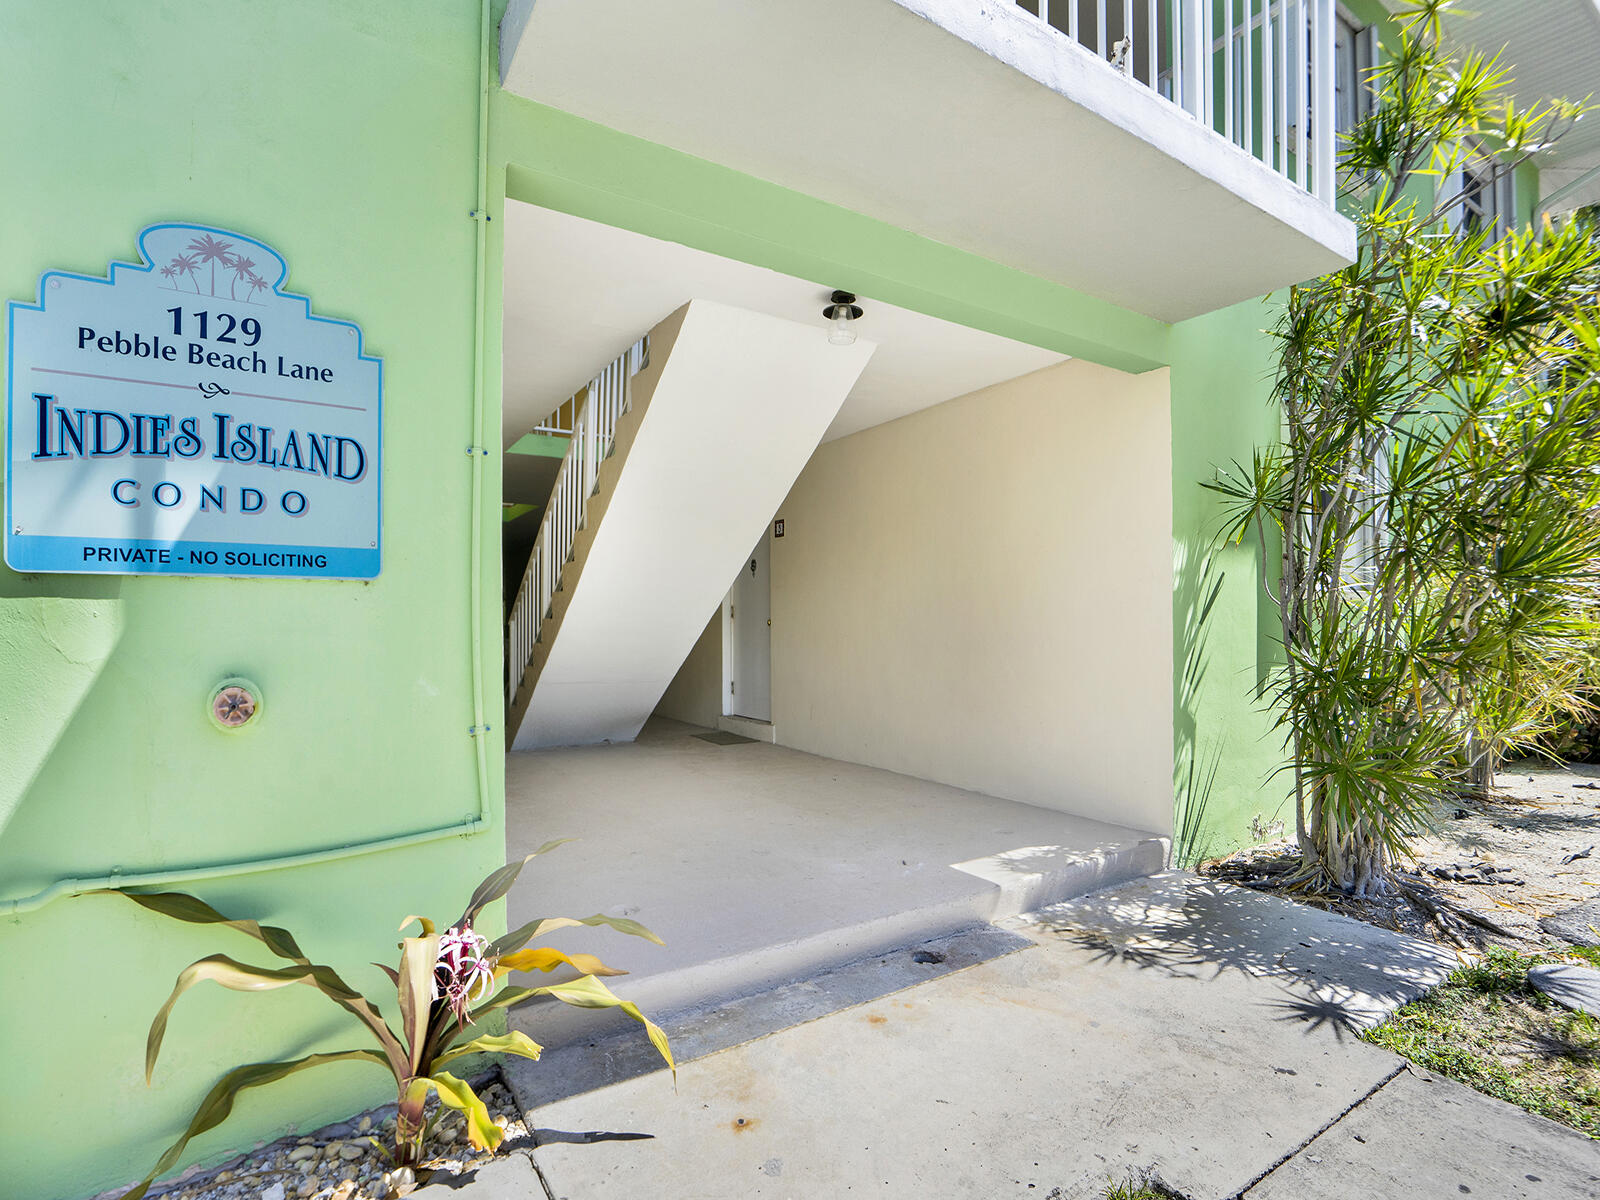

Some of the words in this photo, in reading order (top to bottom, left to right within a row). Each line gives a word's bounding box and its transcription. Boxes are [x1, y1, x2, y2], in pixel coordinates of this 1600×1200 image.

[167, 306, 262, 346] 1129
[77, 326, 177, 362] Pebble
[188, 343, 267, 374] Beach
[277, 356, 334, 383] Lane
[32, 392, 204, 460] INDIES
[212, 412, 368, 483] ISLAND
[111, 478, 309, 516] CONDO
[83, 546, 171, 564] PRIVATE
[190, 550, 218, 566] NO
[224, 551, 327, 568] SOLICITING
